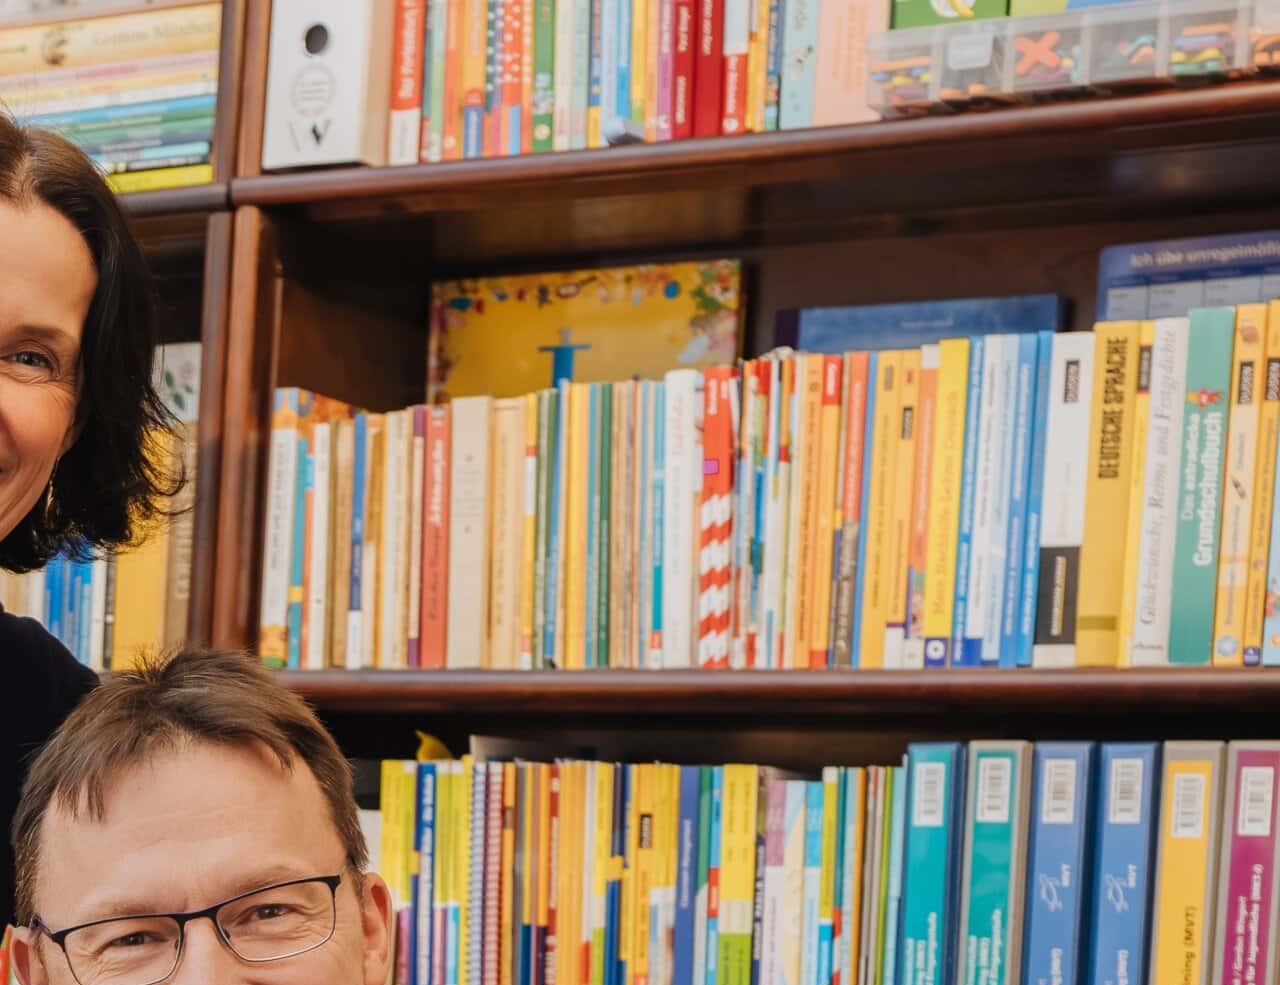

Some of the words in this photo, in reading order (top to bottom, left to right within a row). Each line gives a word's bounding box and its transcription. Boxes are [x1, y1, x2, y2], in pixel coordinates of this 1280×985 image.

[1102, 335, 1128, 405] SPRACHE
[1240, 366, 1251, 402] DUDEN
[1097, 407, 1123, 480] DEUTSCHE
[1191, 410, 1224, 566] Grundschulbuch
[1184, 905, 1196, 945] (MVT)
